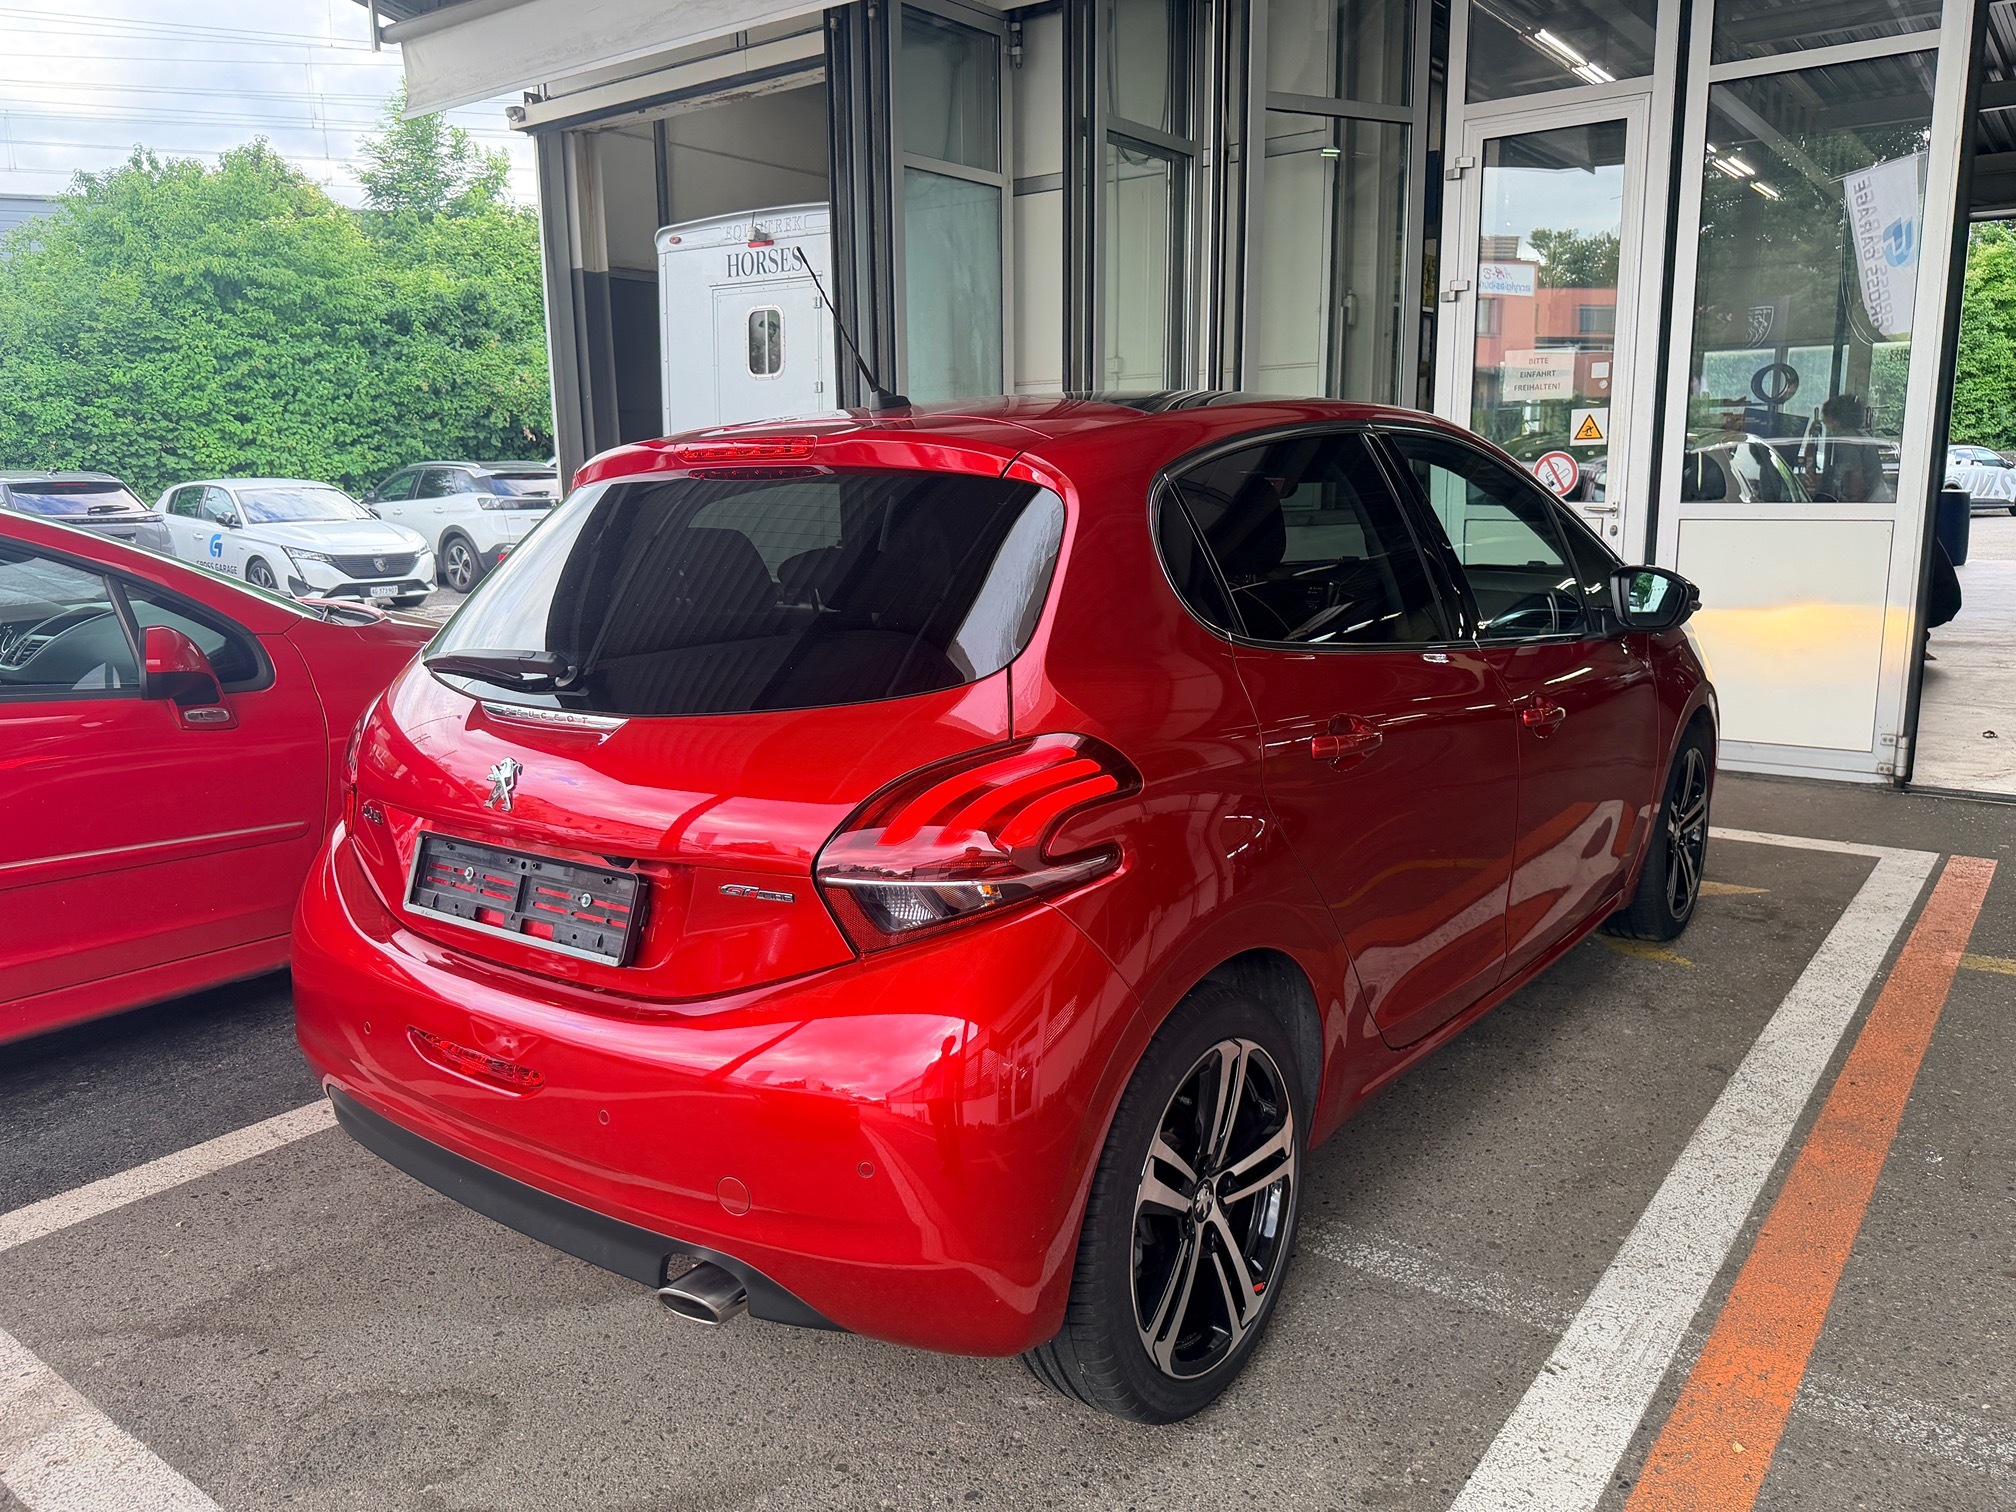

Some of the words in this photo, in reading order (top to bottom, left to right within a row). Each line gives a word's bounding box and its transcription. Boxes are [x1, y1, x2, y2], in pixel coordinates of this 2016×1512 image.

[727, 246, 803, 278] HORSES
[1528, 357, 1549, 365] BITTE
[1519, 370, 1556, 378] EINFAHRT
[1513, 382, 1561, 391] FREIHALTEN!
[215, 563, 238, 575] GARAGE
[504, 707, 589, 724] PEUGEOT
